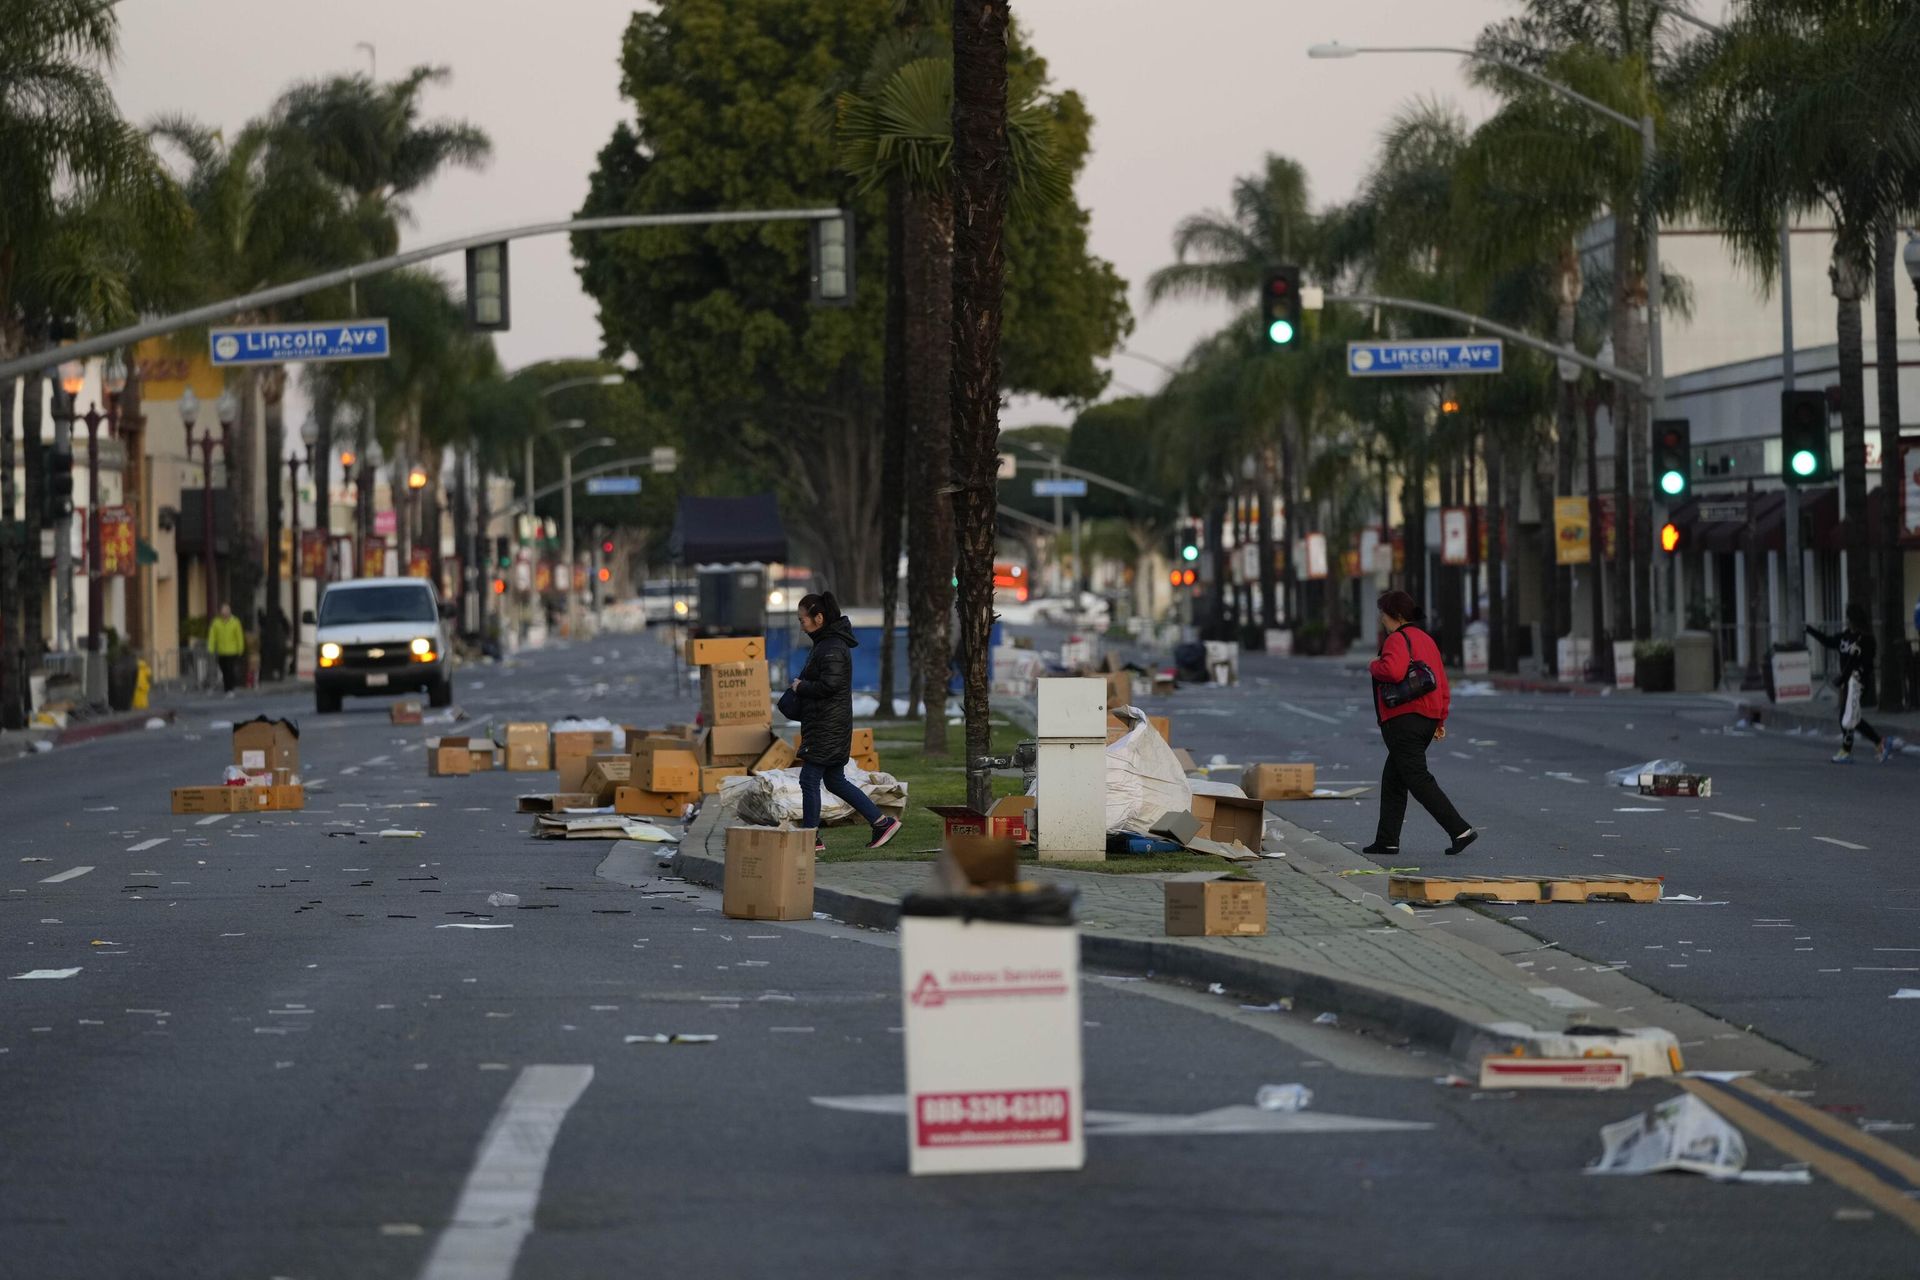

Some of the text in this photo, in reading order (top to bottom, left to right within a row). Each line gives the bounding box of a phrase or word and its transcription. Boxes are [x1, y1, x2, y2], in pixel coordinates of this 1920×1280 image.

[247, 327, 377, 351] Lincoln Ave
[273, 347, 352, 358] MONTEREY PARK
[1380, 346, 1492, 363] Lincoln Ave
[718, 668, 754, 678] SHAMMY
[718, 679, 746, 688] CLOTH
[720, 710, 766, 719] MADE IN CHINA
